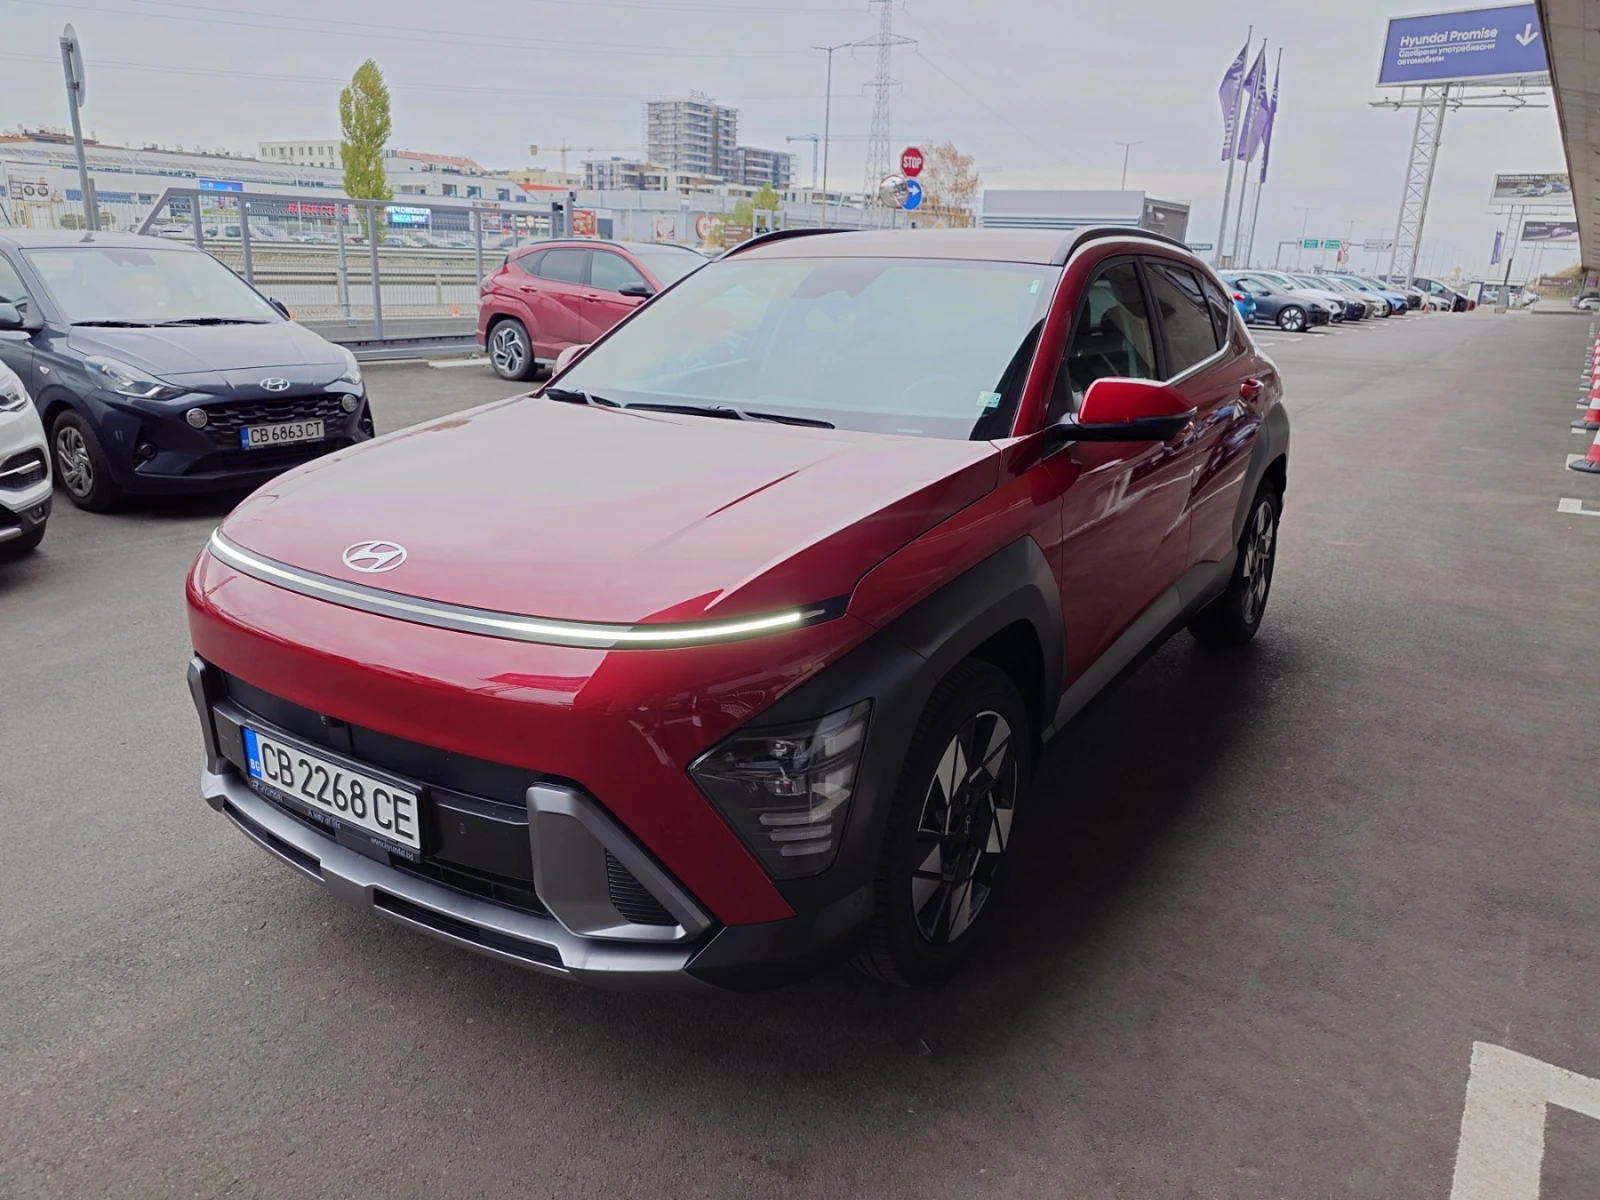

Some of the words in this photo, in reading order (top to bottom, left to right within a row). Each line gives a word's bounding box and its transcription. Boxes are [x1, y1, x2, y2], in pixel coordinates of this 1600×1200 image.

[1400, 32, 1448, 46] Hyundai
[1450, 28, 1498, 41] Promise
[1398, 48, 1438, 58] Одобрени
[1438, 43, 1496, 55] употребявани
[1396, 55, 1445, 65] автомобили
[903, 156, 922, 169] STOP
[251, 429, 269, 443] CB
[272, 425, 303, 440] 6863
[305, 422, 321, 437] CT
[250, 758, 261, 771] BG
[261, 742, 294, 788] CB
[298, 758, 367, 819] 2268
[373, 788, 414, 840] CE
